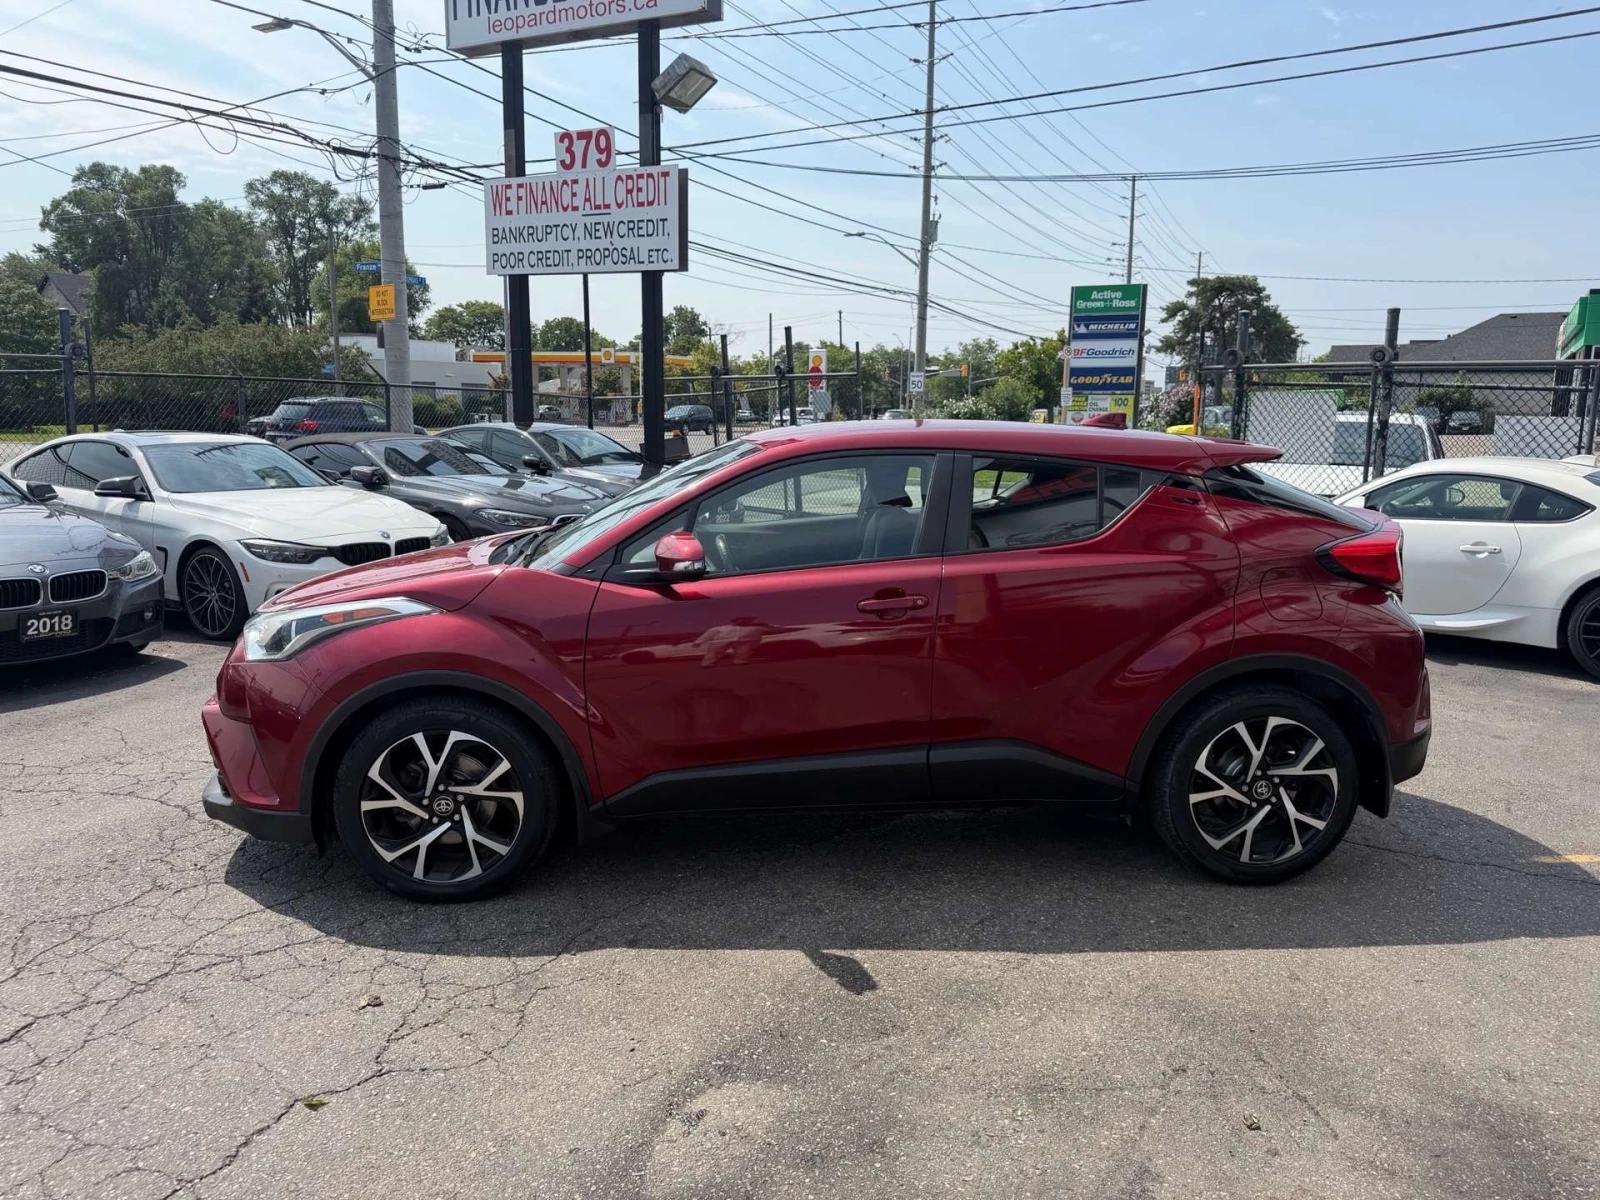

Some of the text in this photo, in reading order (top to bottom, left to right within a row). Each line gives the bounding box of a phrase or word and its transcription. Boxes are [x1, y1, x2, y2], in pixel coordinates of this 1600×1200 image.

[487, 0, 657, 34] leopardmotors.ca
[558, 128, 612, 171] 379
[490, 170, 670, 217] WE FINANCE ALL CREDIT
[491, 217, 671, 245] BANKRUPTCY, NEW CREDIT,
[493, 250, 525, 270] POOR
[527, 248, 575, 270] CREDIT,
[647, 248, 673, 265] ETC.
[1091, 290, 1122, 299] Active
[1073, 347, 1134, 356] BFGoodrich
[911, 380, 922, 389] 50
[26, 614, 73, 635] 2018
